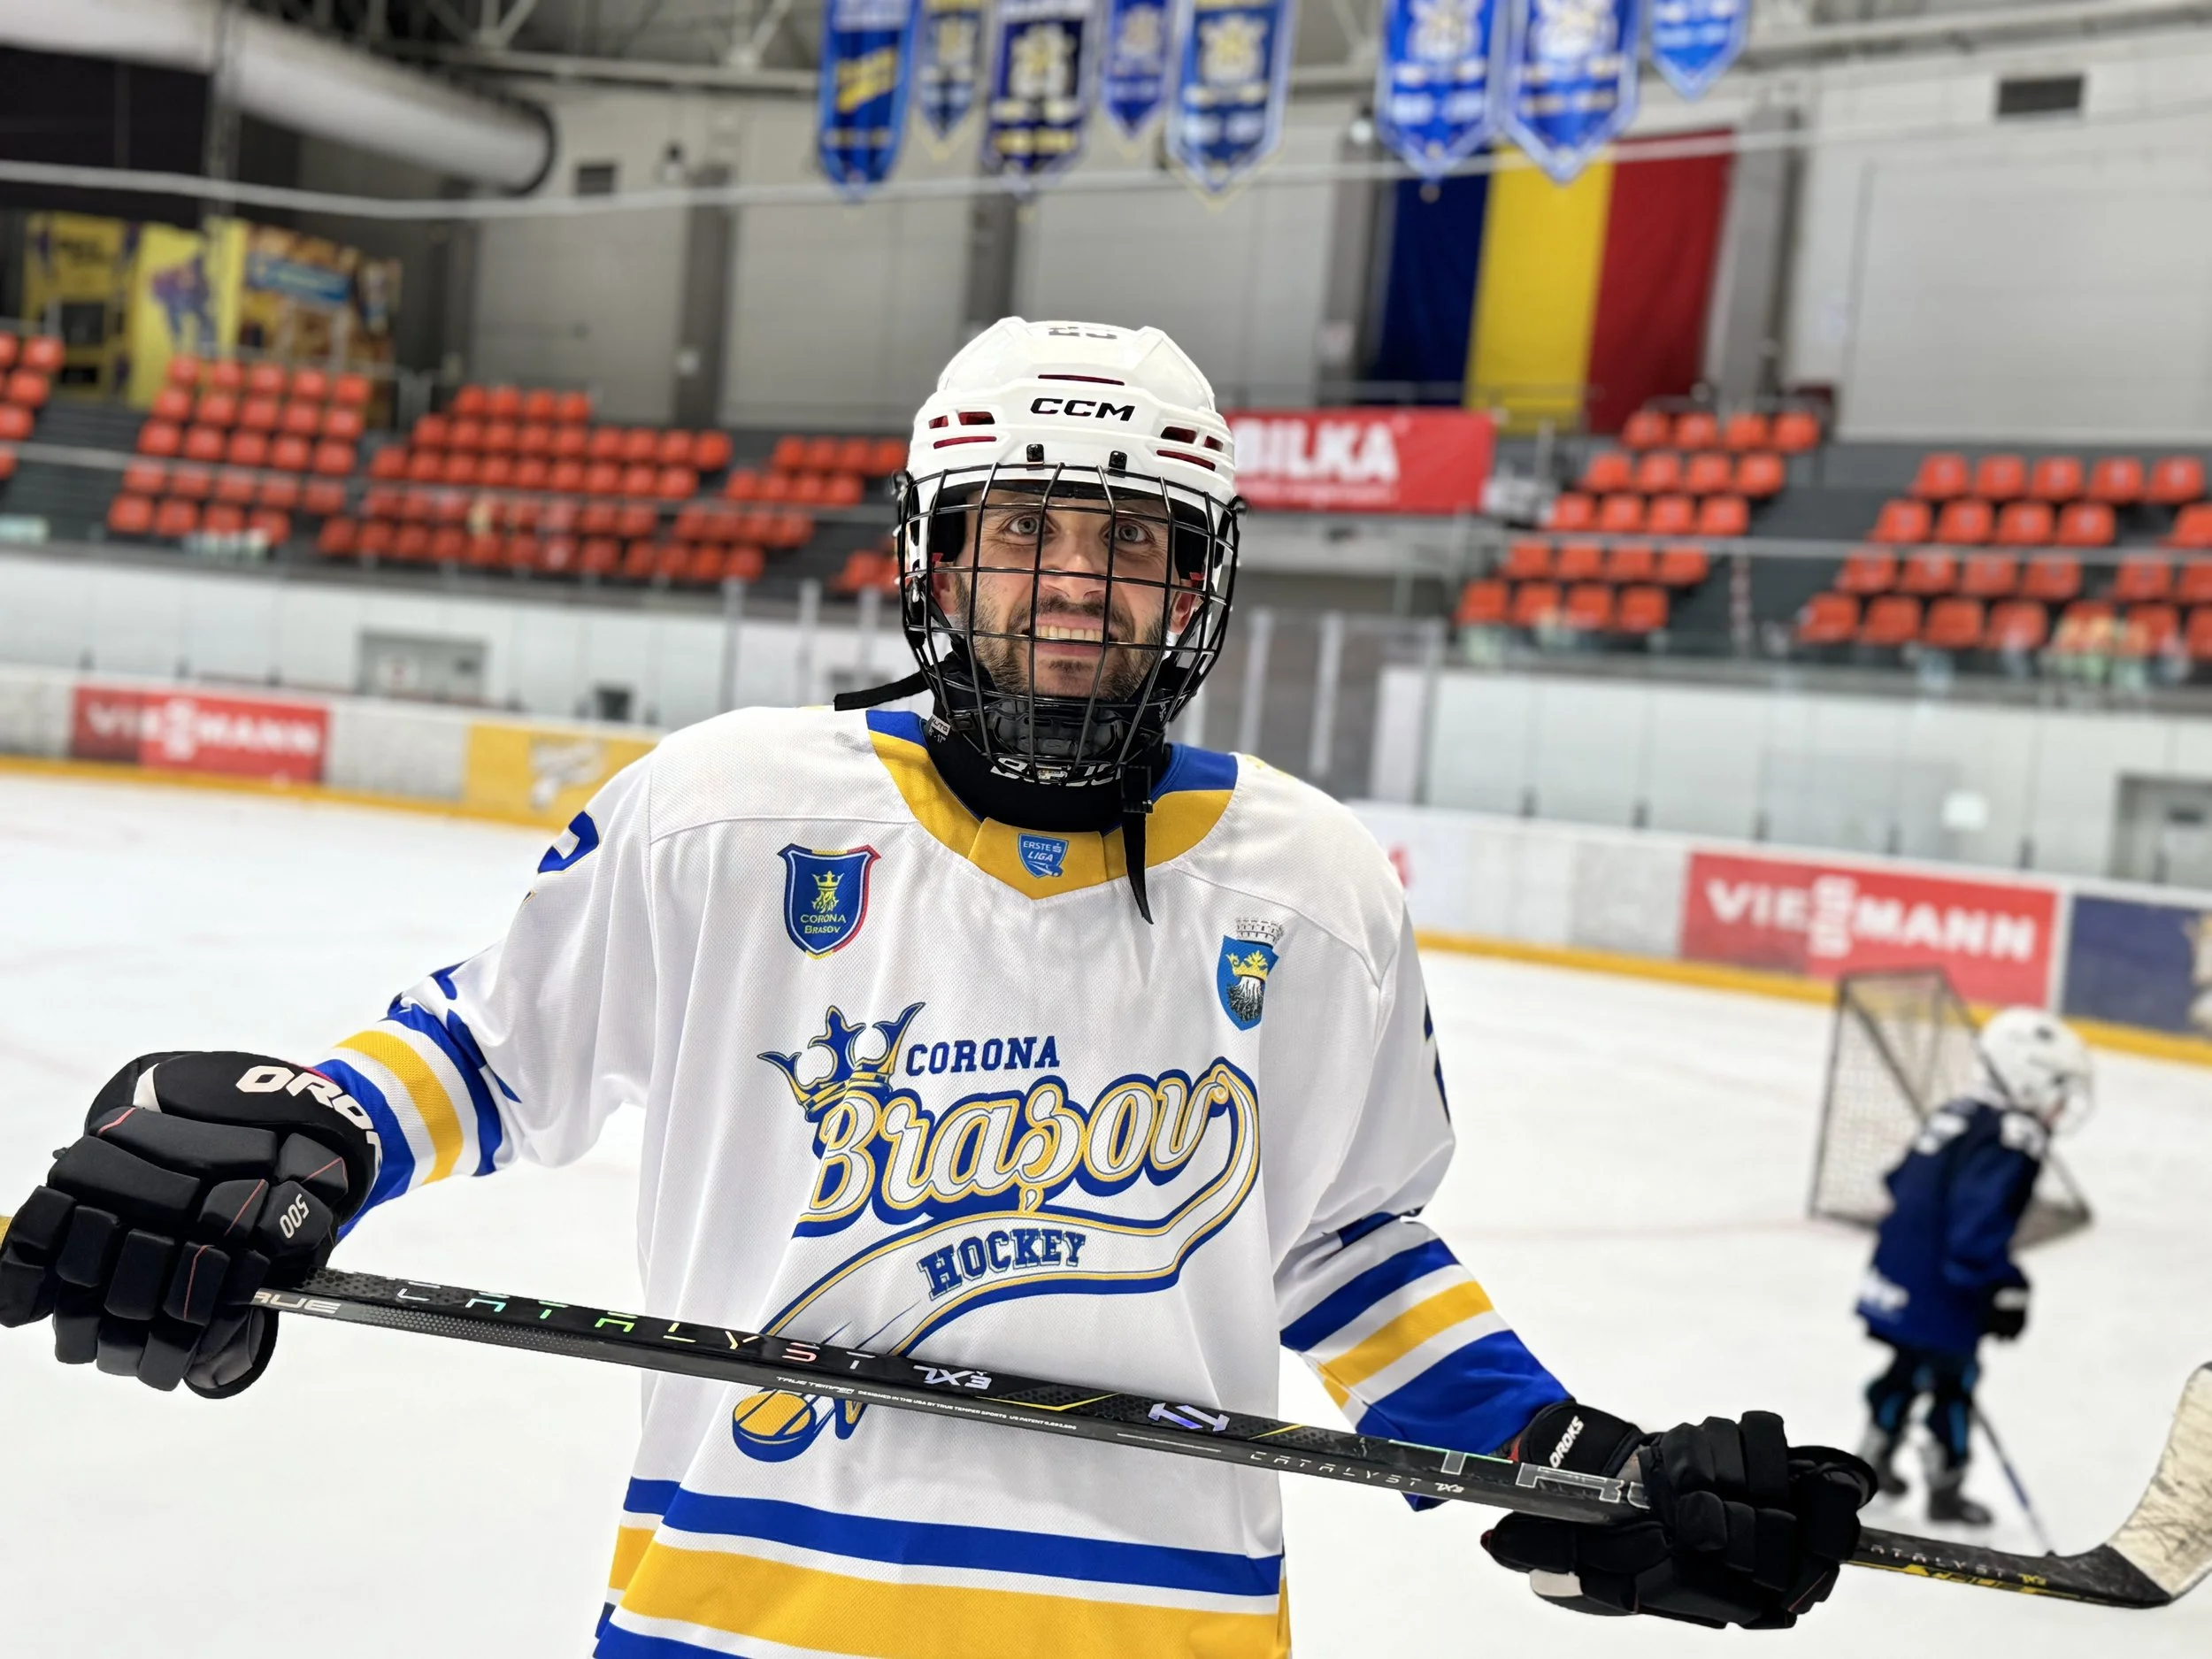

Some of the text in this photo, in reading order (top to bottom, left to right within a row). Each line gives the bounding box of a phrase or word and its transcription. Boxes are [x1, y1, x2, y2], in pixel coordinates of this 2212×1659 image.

[1030, 397, 1135, 421] CCM
[1023, 841, 1051, 852] ERSTE
[1027, 850, 1054, 863] LIGA
[800, 914, 847, 924] CORONA
[1706, 874, 2035, 963] VIESSMANN
[906, 1036, 1060, 1076] CORONA
[280, 1193, 310, 1239] 500
[917, 1230, 1086, 1301] HOCKEY
[397, 1279, 876, 1370] CATALYST
[776, 1376, 806, 1386] TRUE
[808, 1381, 855, 1394] TEMPER
[857, 1390, 891, 1400] DESIGNED
[955, 1406, 980, 1415] TEMPER
[981, 1410, 1007, 1419] SPORTS
[1548, 1416, 1584, 1469] OROKS
[1250, 1451, 1422, 1486] CATALYST
